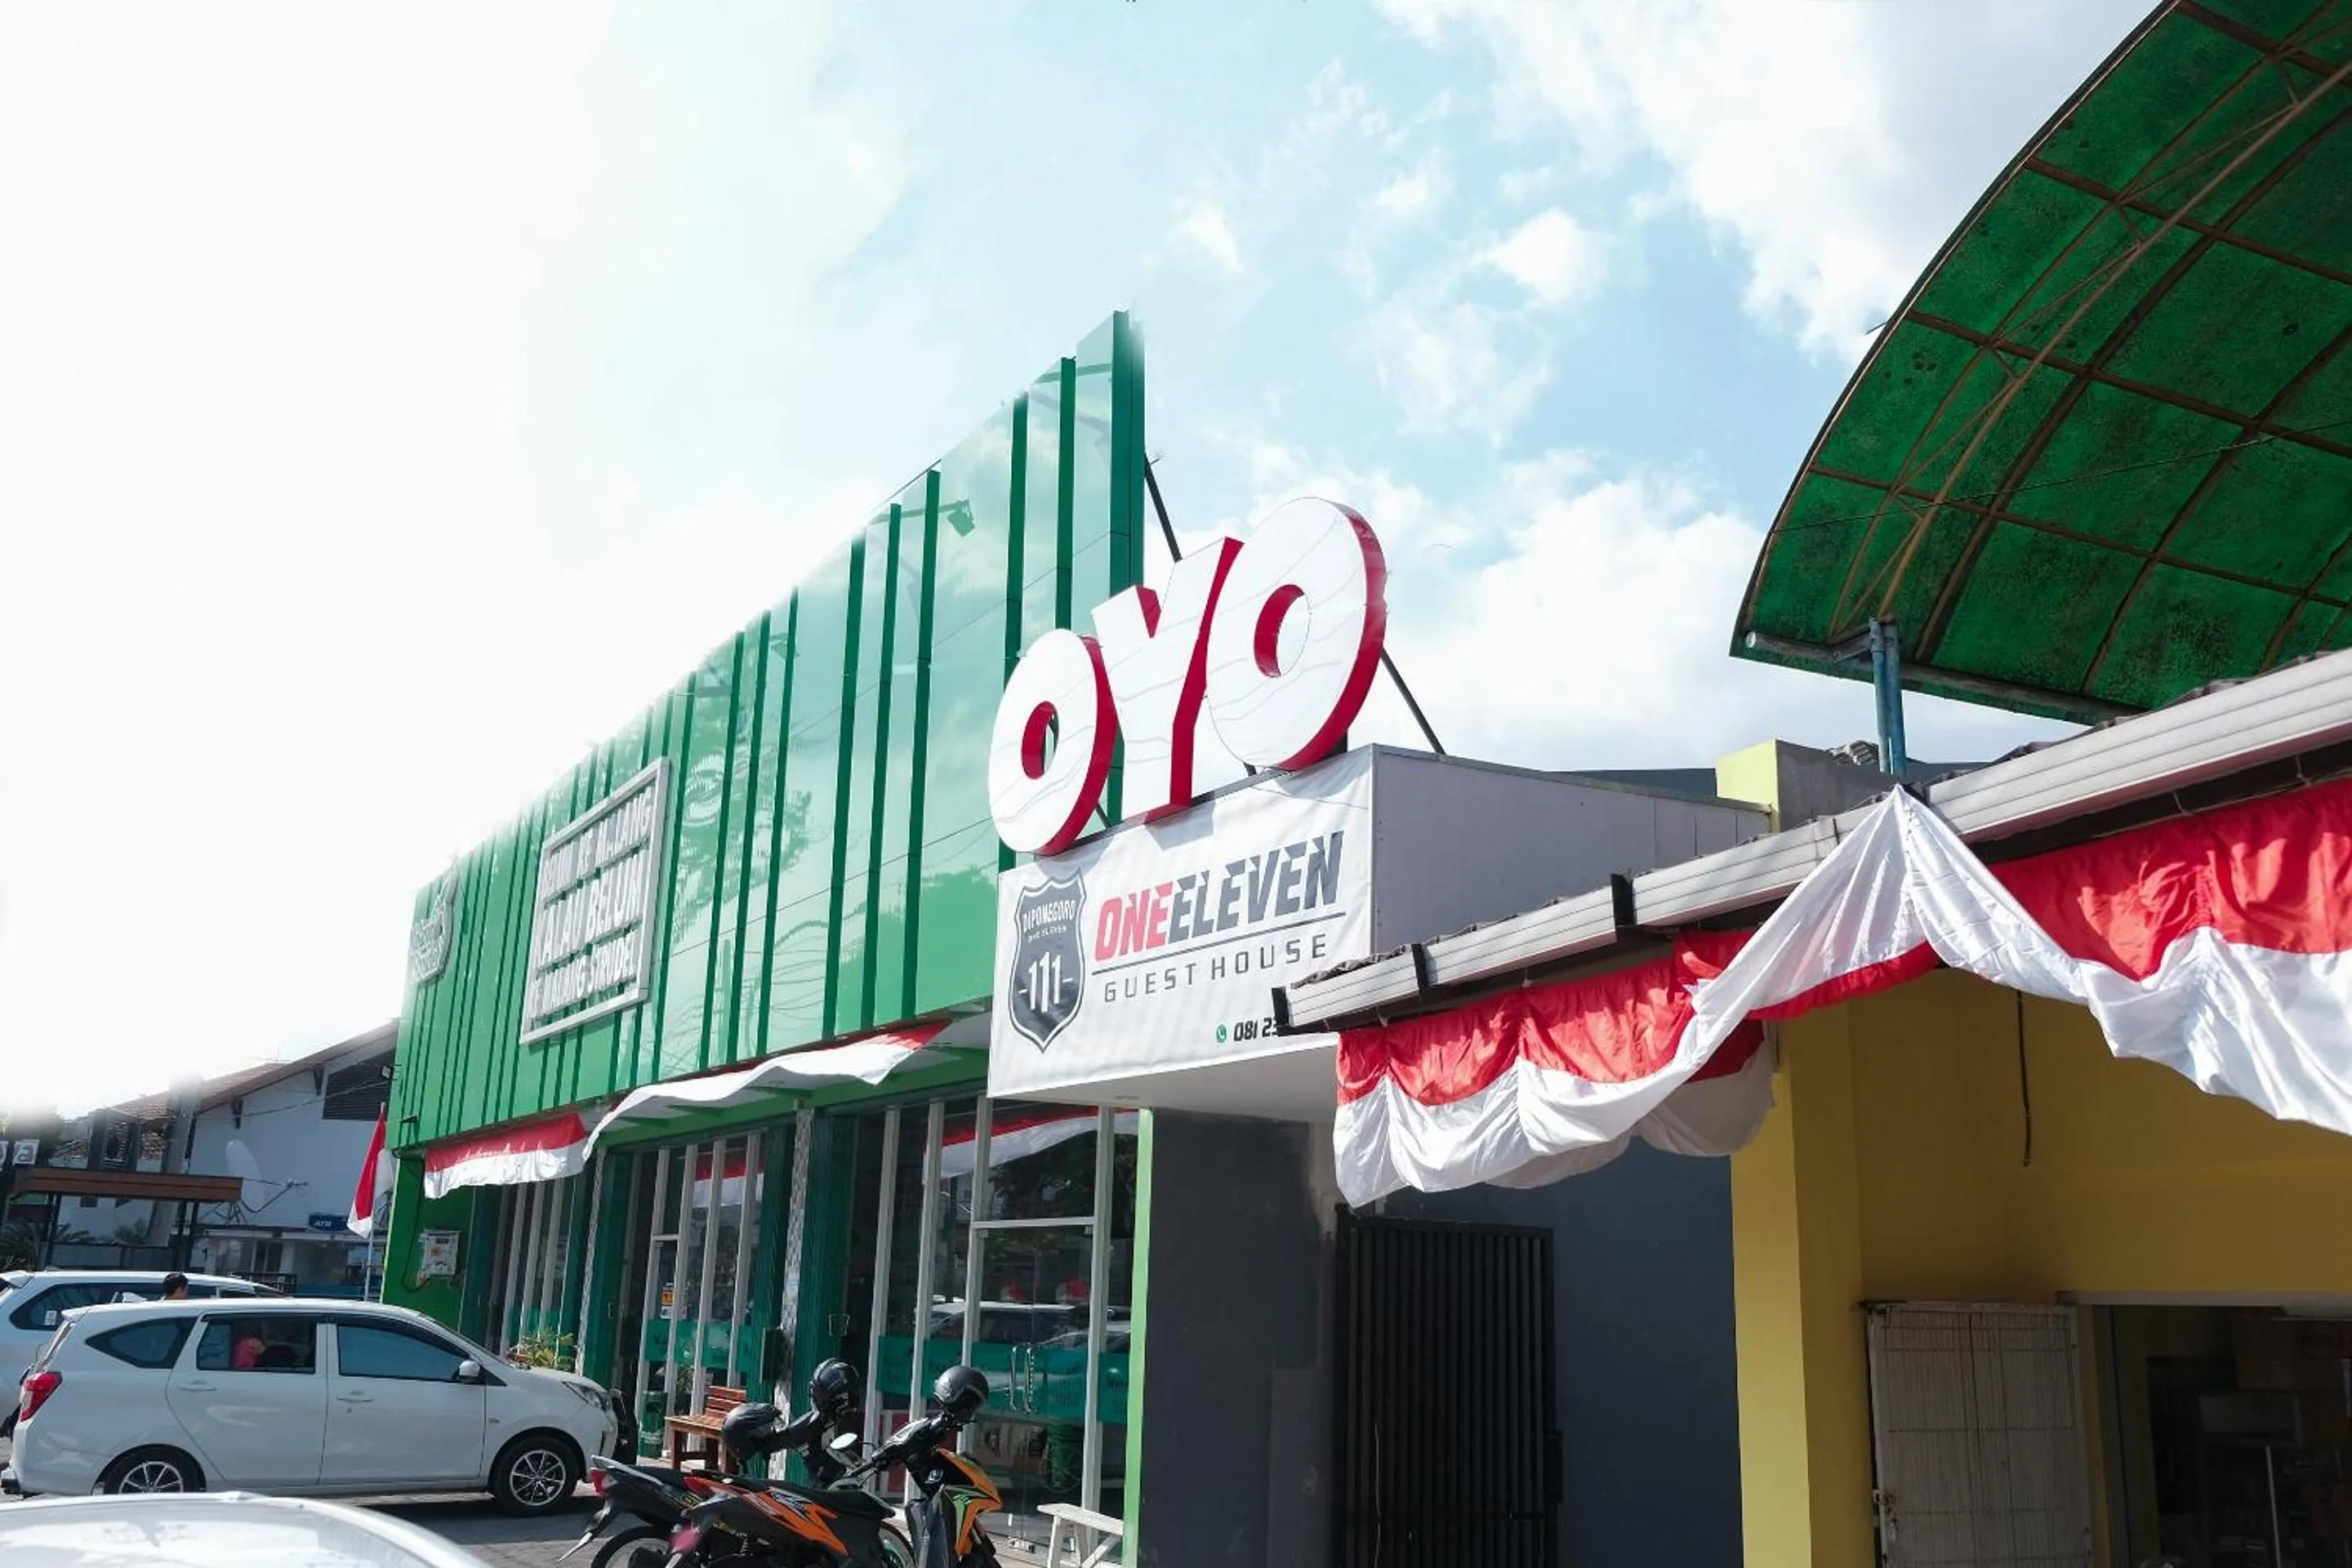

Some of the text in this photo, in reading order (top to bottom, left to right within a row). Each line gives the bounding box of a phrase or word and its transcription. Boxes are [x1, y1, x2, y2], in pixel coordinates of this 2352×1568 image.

[988, 497, 1387, 856] OYO
[1028, 951, 1061, 1013] 111
[1104, 933, 1326, 1003] GUEST HOUSE
[1233, 1019, 1258, 1042] 081
